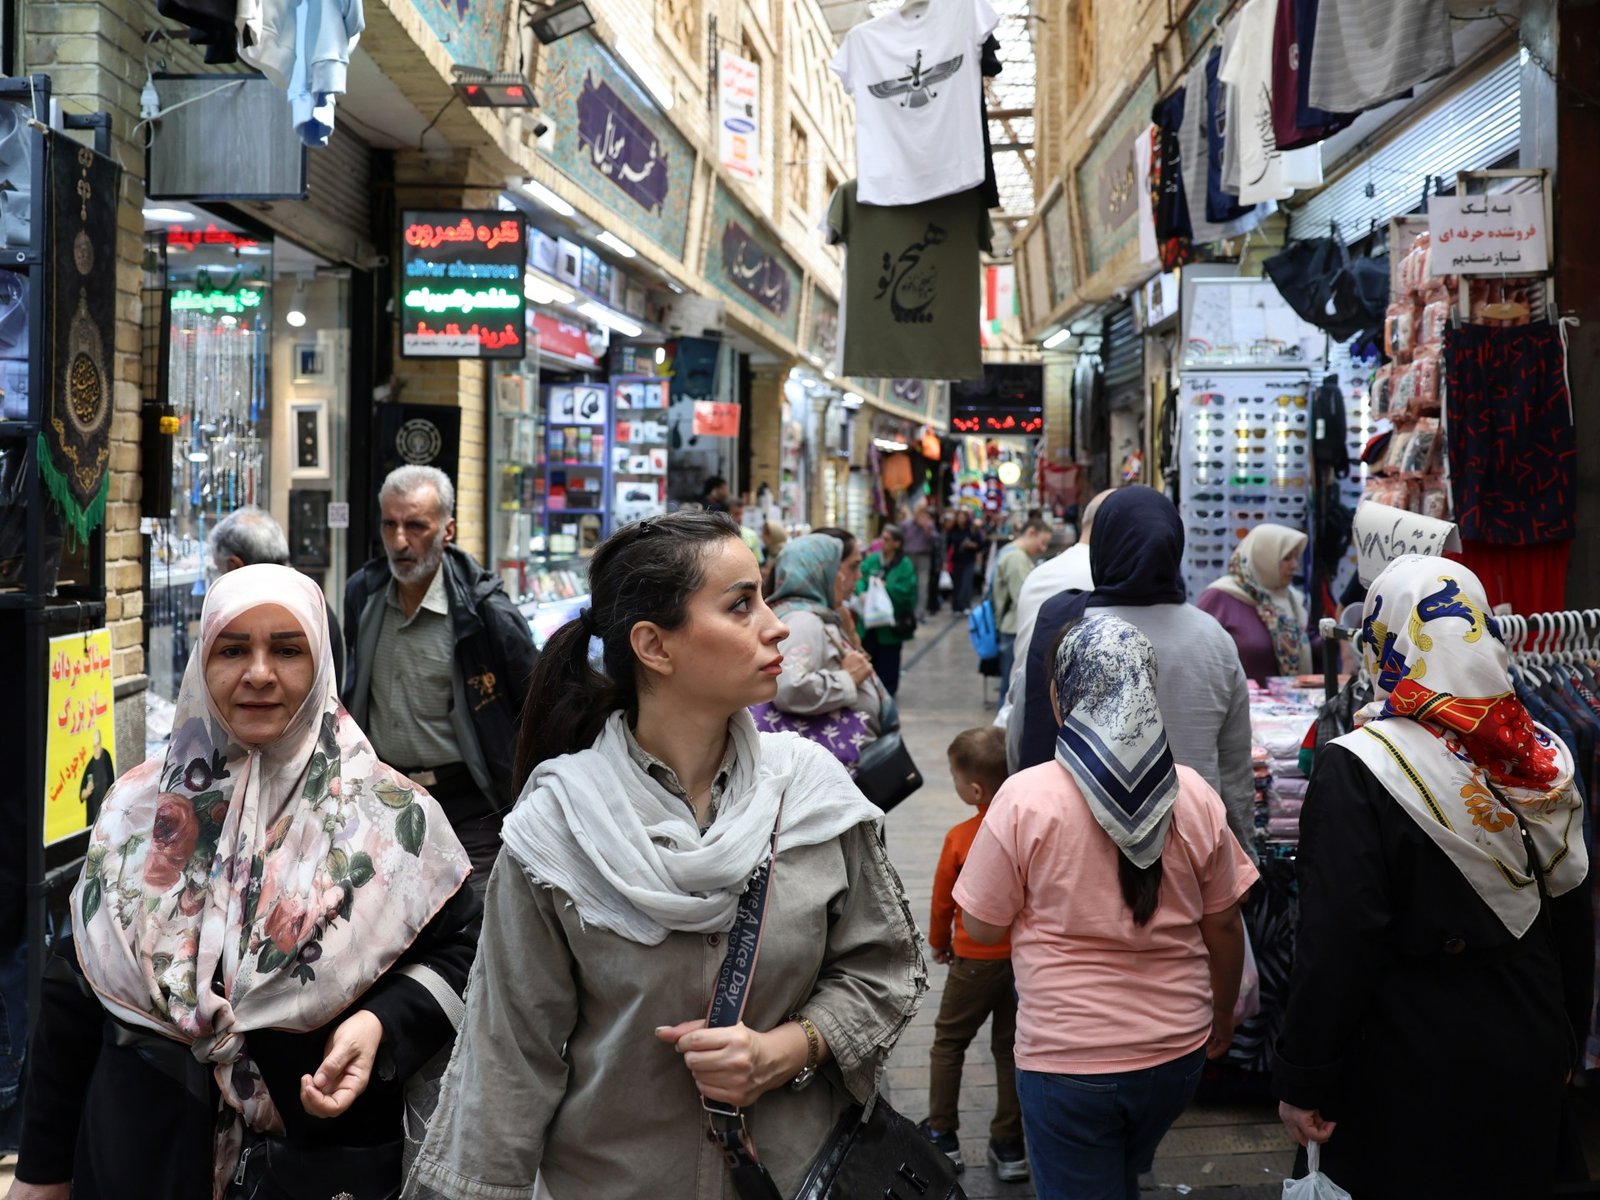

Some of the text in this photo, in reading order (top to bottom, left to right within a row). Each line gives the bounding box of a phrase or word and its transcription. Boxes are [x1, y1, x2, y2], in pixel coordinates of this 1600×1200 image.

[594, 110, 626, 174] موبایل
[1460, 202, 1512, 217] به یک
[405, 217, 519, 249] نقره شمرون
[1438, 223, 1537, 243] فروشنده حرفه ای
[1452, 250, 1521, 267] نیازمندیم
[51, 650, 80, 688] مردانه
[57, 690, 108, 735] سایز بزرگ
[50, 746, 87, 801] موجود است
[736, 929, 757, 968] Nice
[724, 970, 747, 1008] Day
[711, 1007, 721, 1024] FLY
